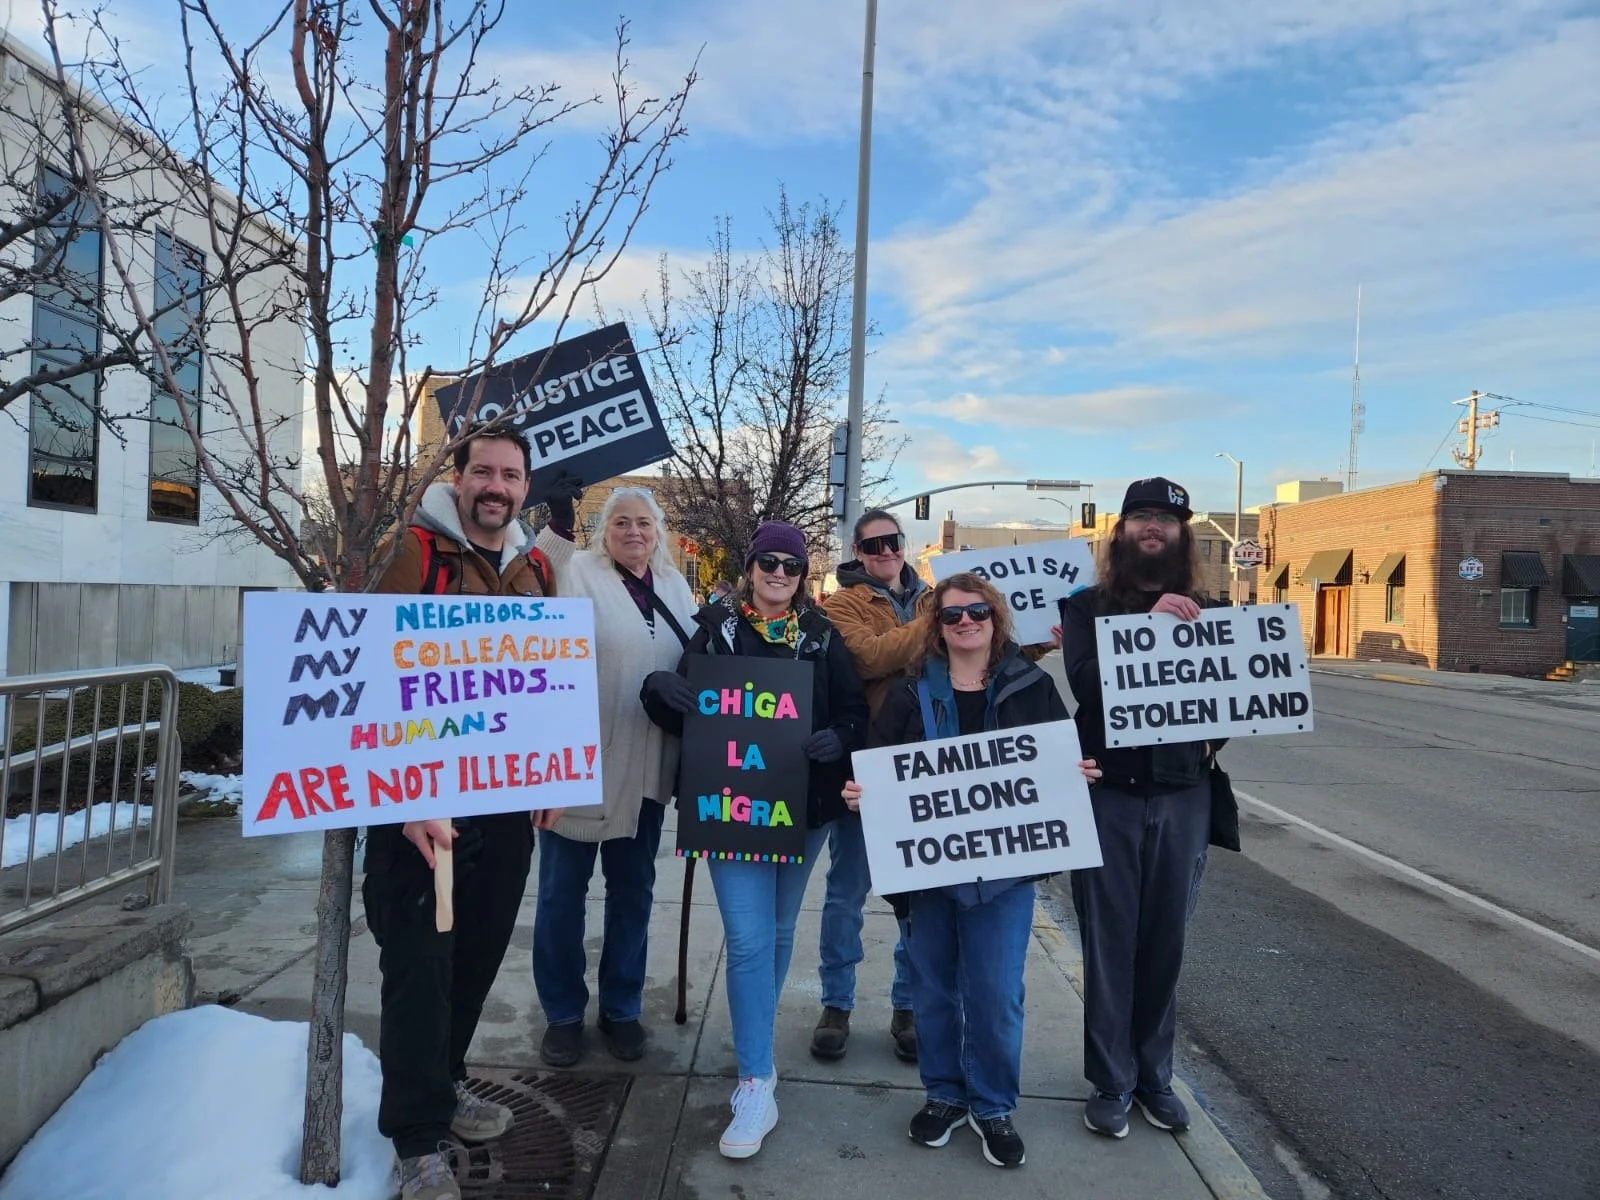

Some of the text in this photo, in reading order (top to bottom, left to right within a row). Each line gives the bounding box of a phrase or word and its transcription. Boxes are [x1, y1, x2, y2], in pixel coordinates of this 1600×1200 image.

[512, 356, 634, 425] JUSTICE
[534, 398, 645, 458] PEACE
[969, 556, 1080, 585] BOLISH
[1234, 551, 1264, 559] LIFE
[1010, 588, 1046, 612] CE
[294, 607, 368, 643] MY
[1112, 616, 1287, 655] NO ONE IS
[288, 634, 591, 683] MY COLLEAGUES
[1116, 652, 1292, 690] ILLEGAL ON
[282, 681, 366, 726] MY
[1109, 691, 1309, 730] STOLEN LAND
[350, 711, 508, 750] HUMANS
[727, 741, 767, 770] LA
[893, 734, 1038, 782] FAMILIES
[254, 744, 597, 823] ARE NOT ILLEGAL!
[909, 777, 1039, 823] BELONG
[896, 819, 1071, 868] TOGETHER
